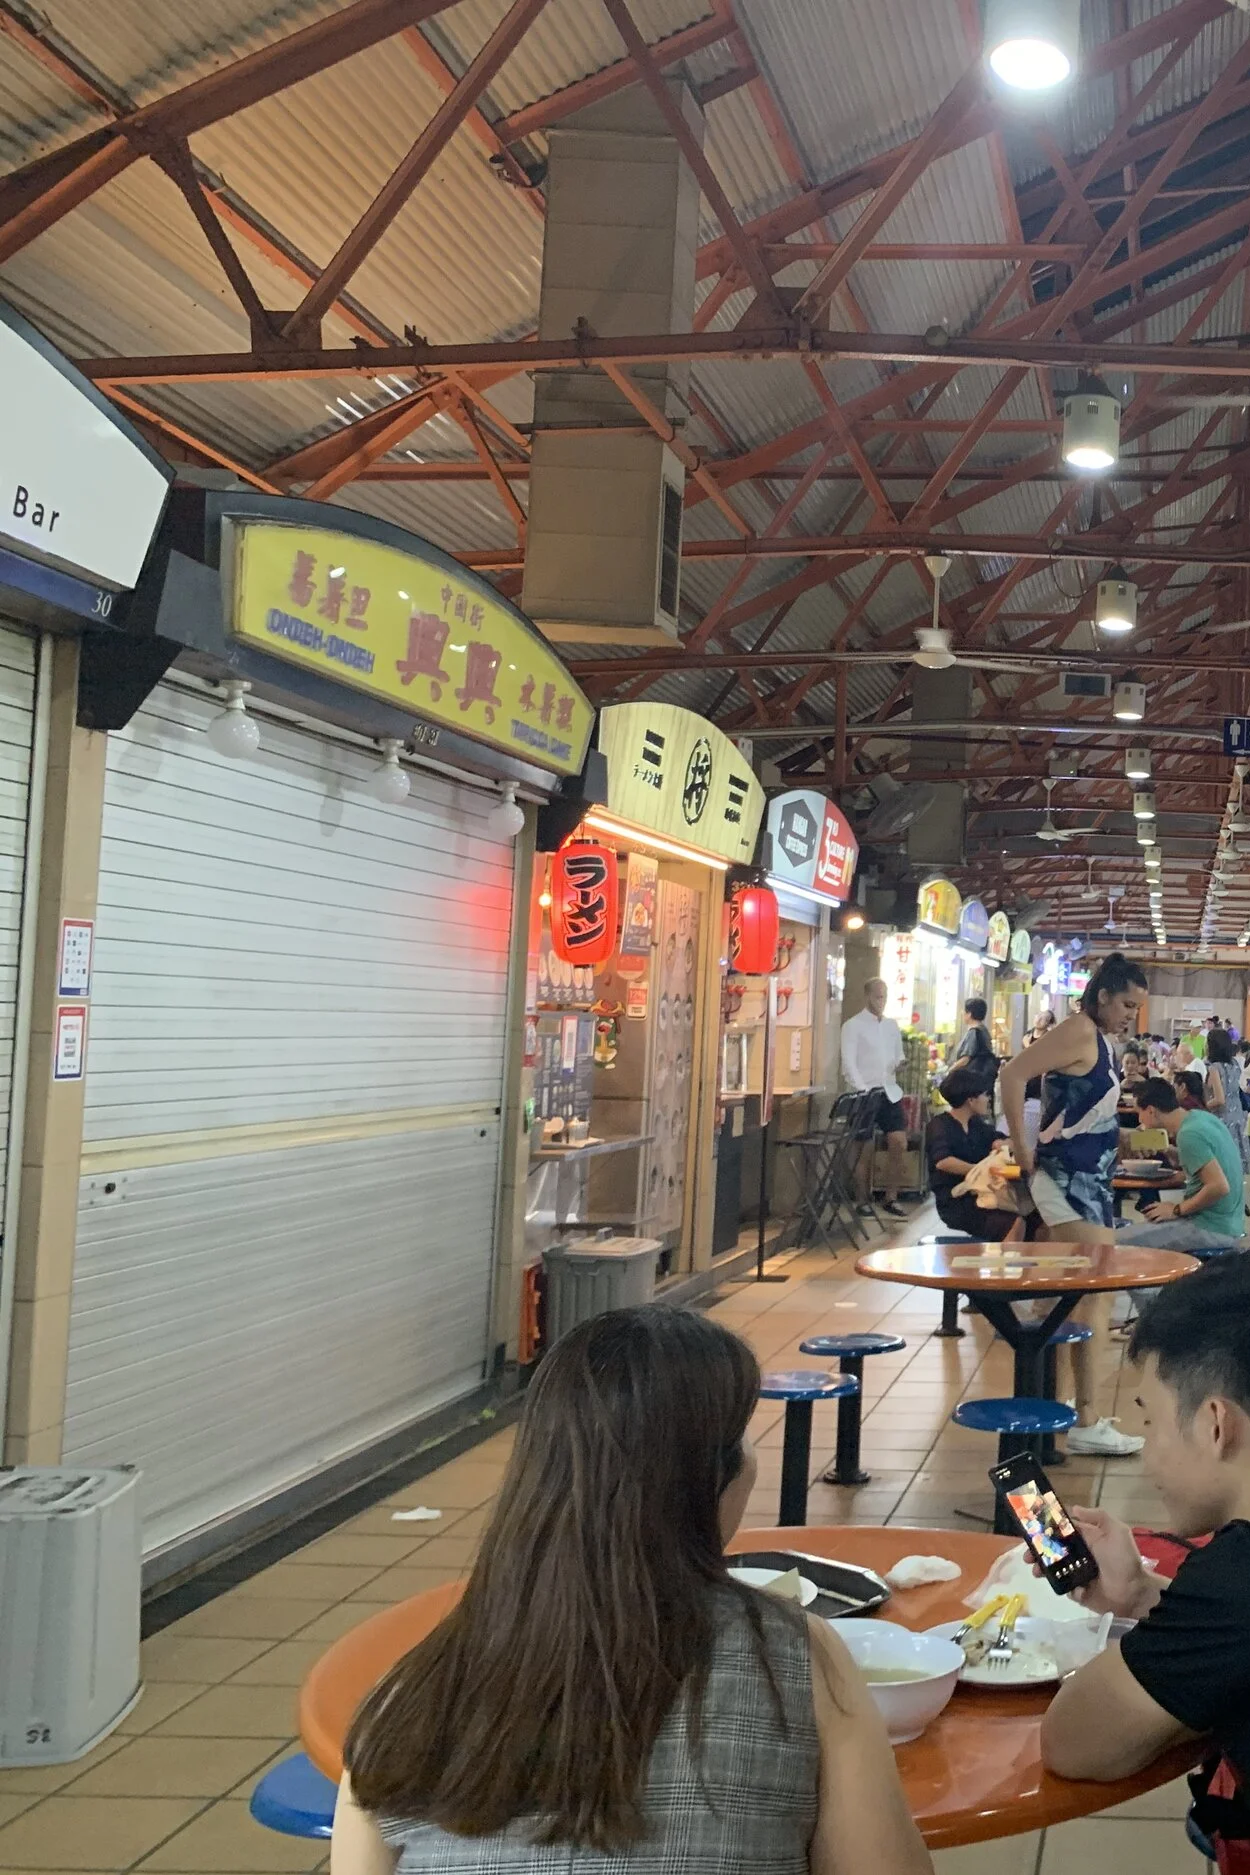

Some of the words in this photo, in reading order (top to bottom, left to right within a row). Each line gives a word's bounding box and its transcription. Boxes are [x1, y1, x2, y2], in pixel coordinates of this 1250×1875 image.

[13, 485, 60, 532] Bar
[91, 591, 112, 616] 30
[565, 856, 607, 947] ラーメン
